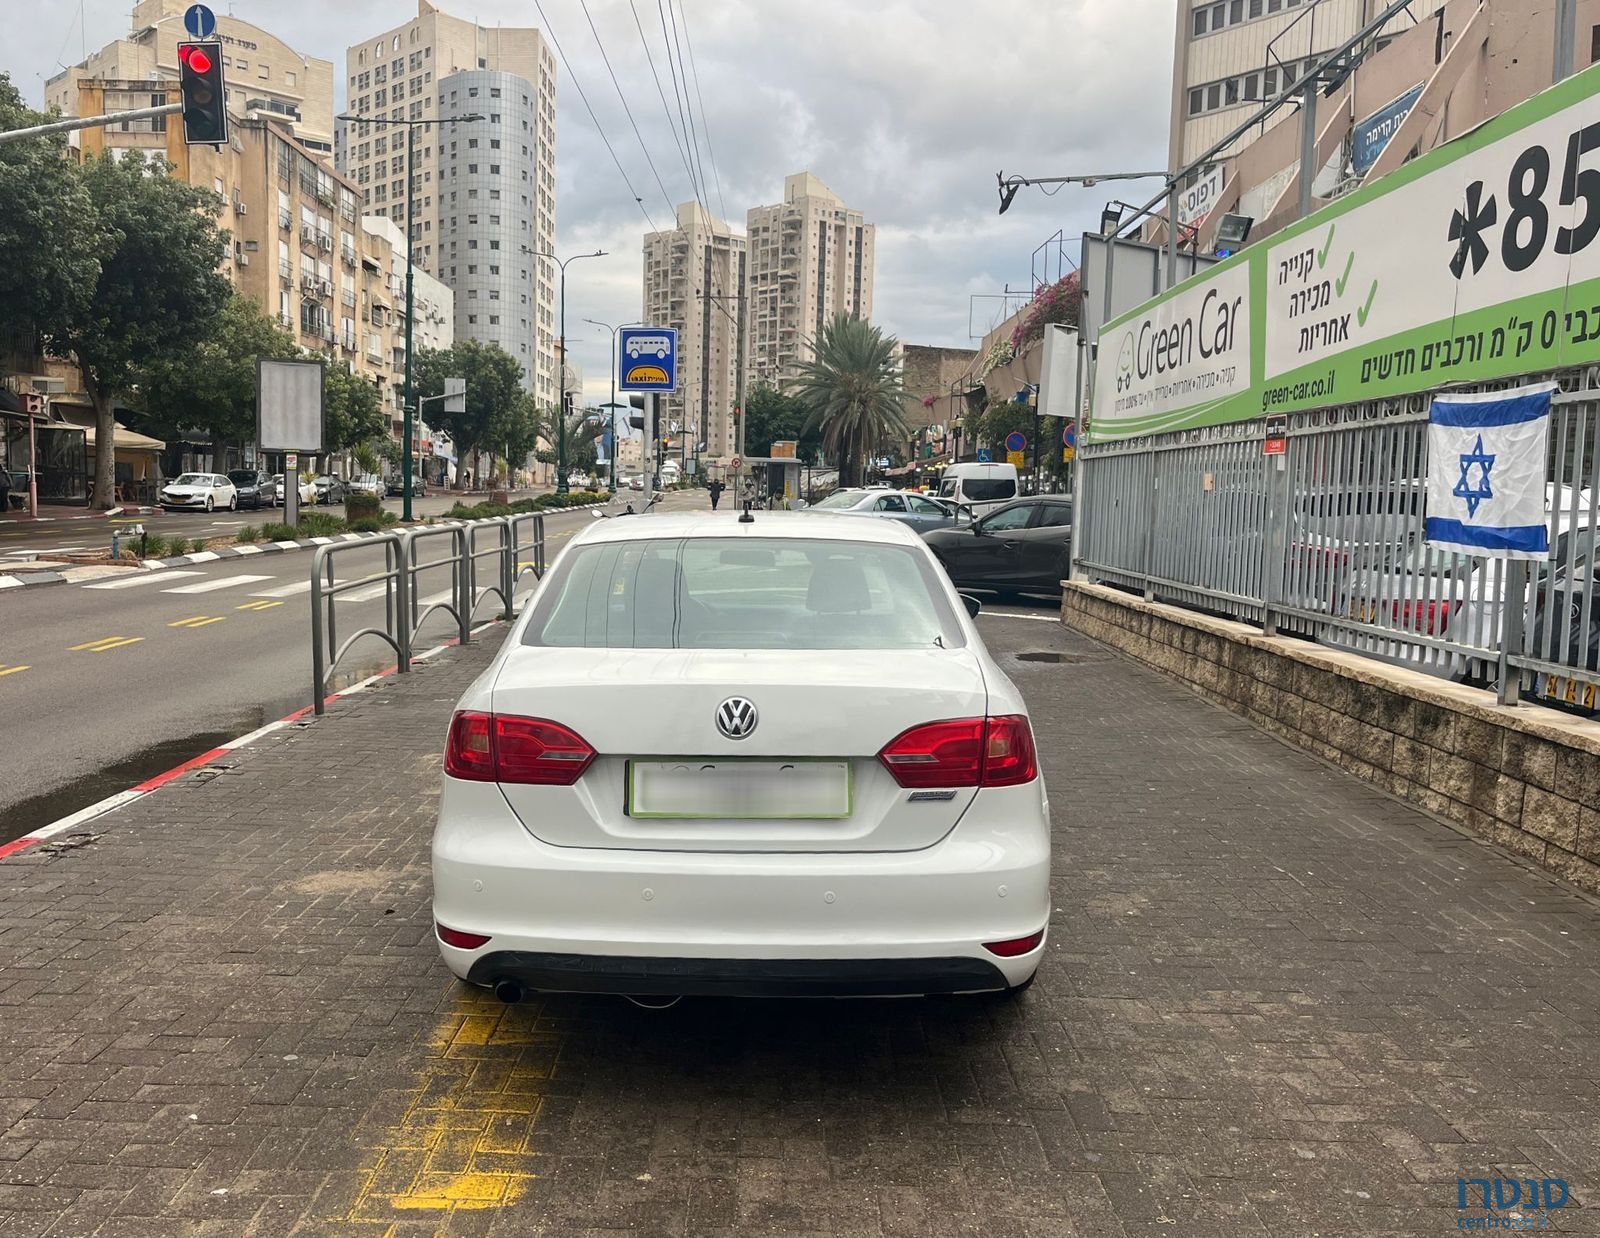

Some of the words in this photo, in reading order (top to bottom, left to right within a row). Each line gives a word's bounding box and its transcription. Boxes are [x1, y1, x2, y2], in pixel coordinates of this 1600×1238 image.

[1365, 119, 1392, 146] קדימה
[1187, 175, 1217, 212] דפוס
[1278, 248, 1315, 286] קנייה
[1289, 280, 1331, 319] מכירה
[1137, 318, 1193, 380] Green
[1199, 288, 1242, 359] Car
[1298, 313, 1351, 353] אחריות
[1540, 309, 1557, 349] 0
[1360, 348, 1416, 384] חדשים
[1421, 331, 1483, 372] ורכבים
[1262, 369, 1336, 412] green-car.co.il
